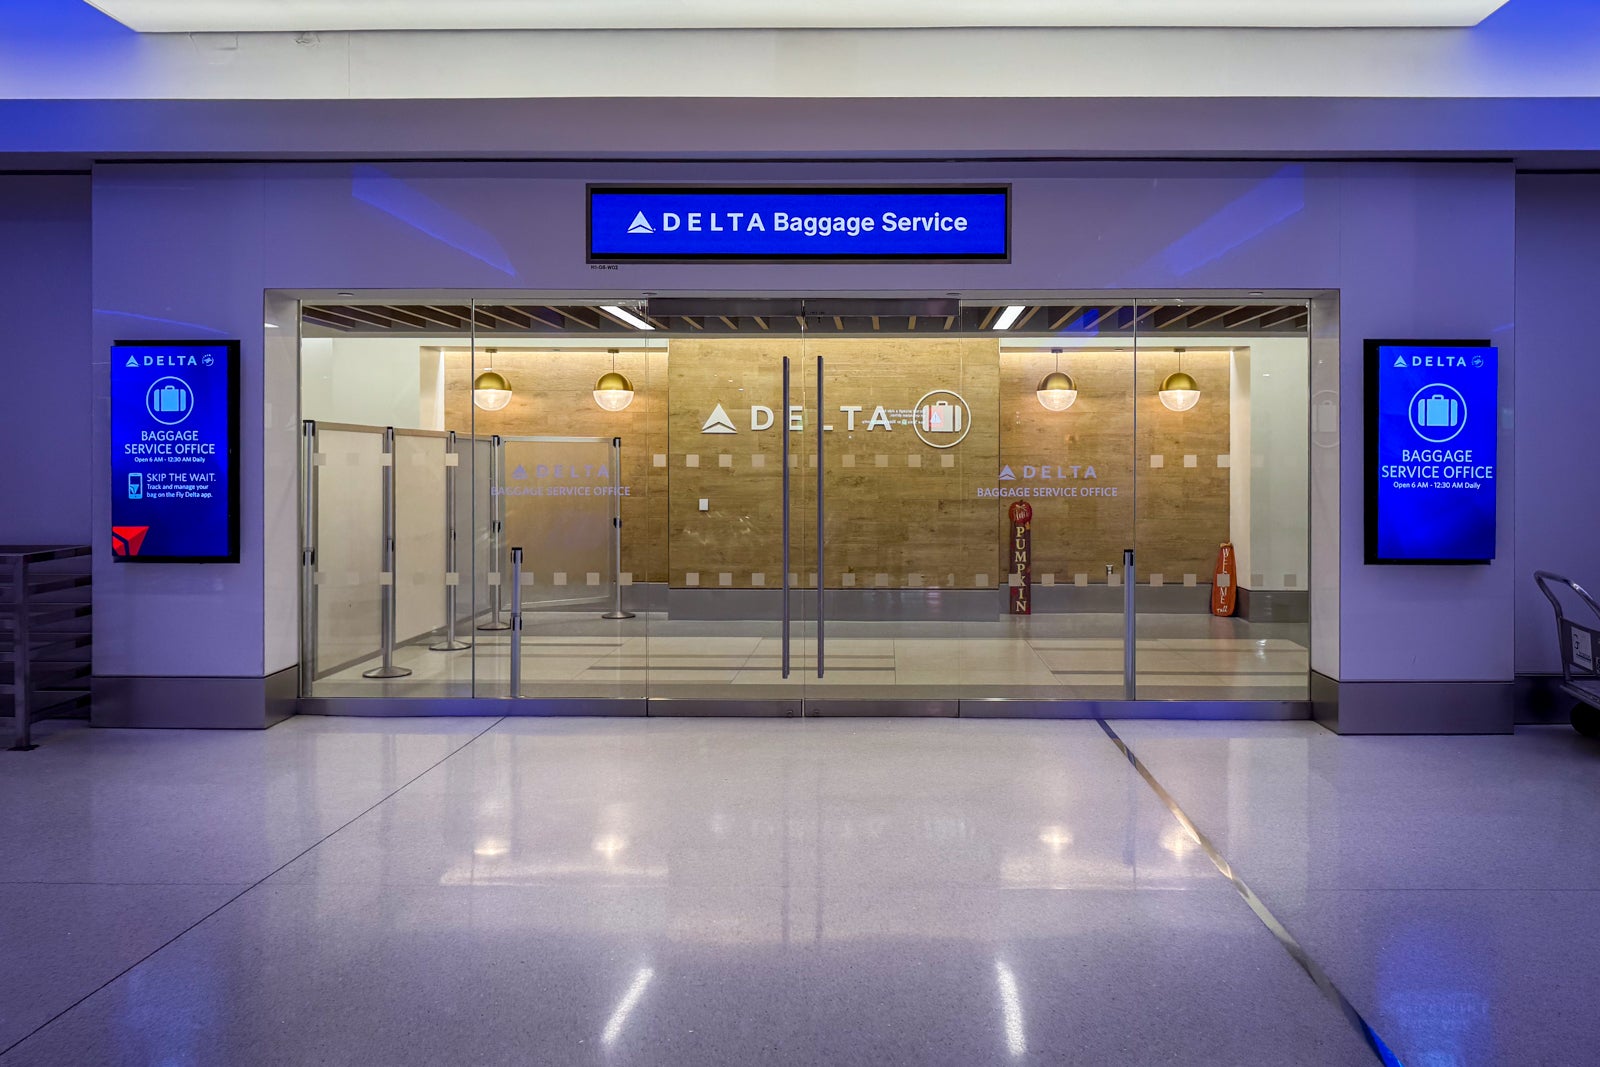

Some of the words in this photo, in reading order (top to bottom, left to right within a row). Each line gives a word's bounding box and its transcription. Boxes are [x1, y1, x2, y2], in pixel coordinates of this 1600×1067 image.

[663, 212, 766, 232] DELTA
[773, 211, 875, 237] Baggage
[881, 211, 968, 232] Service
[143, 355, 198, 366] DELTA
[1411, 355, 1467, 367] DELTA
[141, 430, 199, 441] BAGGAGE
[124, 443, 173, 454] SERVICE
[175, 443, 216, 454] OFFICE
[1402, 449, 1473, 462] BAGGAGE
[536, 464, 610, 479] DELTA
[1023, 465, 1097, 479] DELTA
[1381, 465, 1440, 478] SERVICE
[1443, 465, 1493, 479] OFFICE
[146, 473, 167, 482] SKIP
[168, 473, 187, 482] THE
[189, 473, 216, 482] WAIT.
[1393, 481, 1410, 489] Open
[1464, 481, 1481, 490] Daily
[176, 491, 184, 499] Fly
[490, 486, 544, 497] BAGGAGE
[547, 486, 591, 497] SERVICE
[593, 486, 631, 497] OFFICE
[976, 487, 1031, 497] BAGGAGE
[1033, 487, 1078, 497] SERVICE
[1080, 487, 1118, 497] OFFICE
[1015, 526, 1027, 612] PUMPKIN
